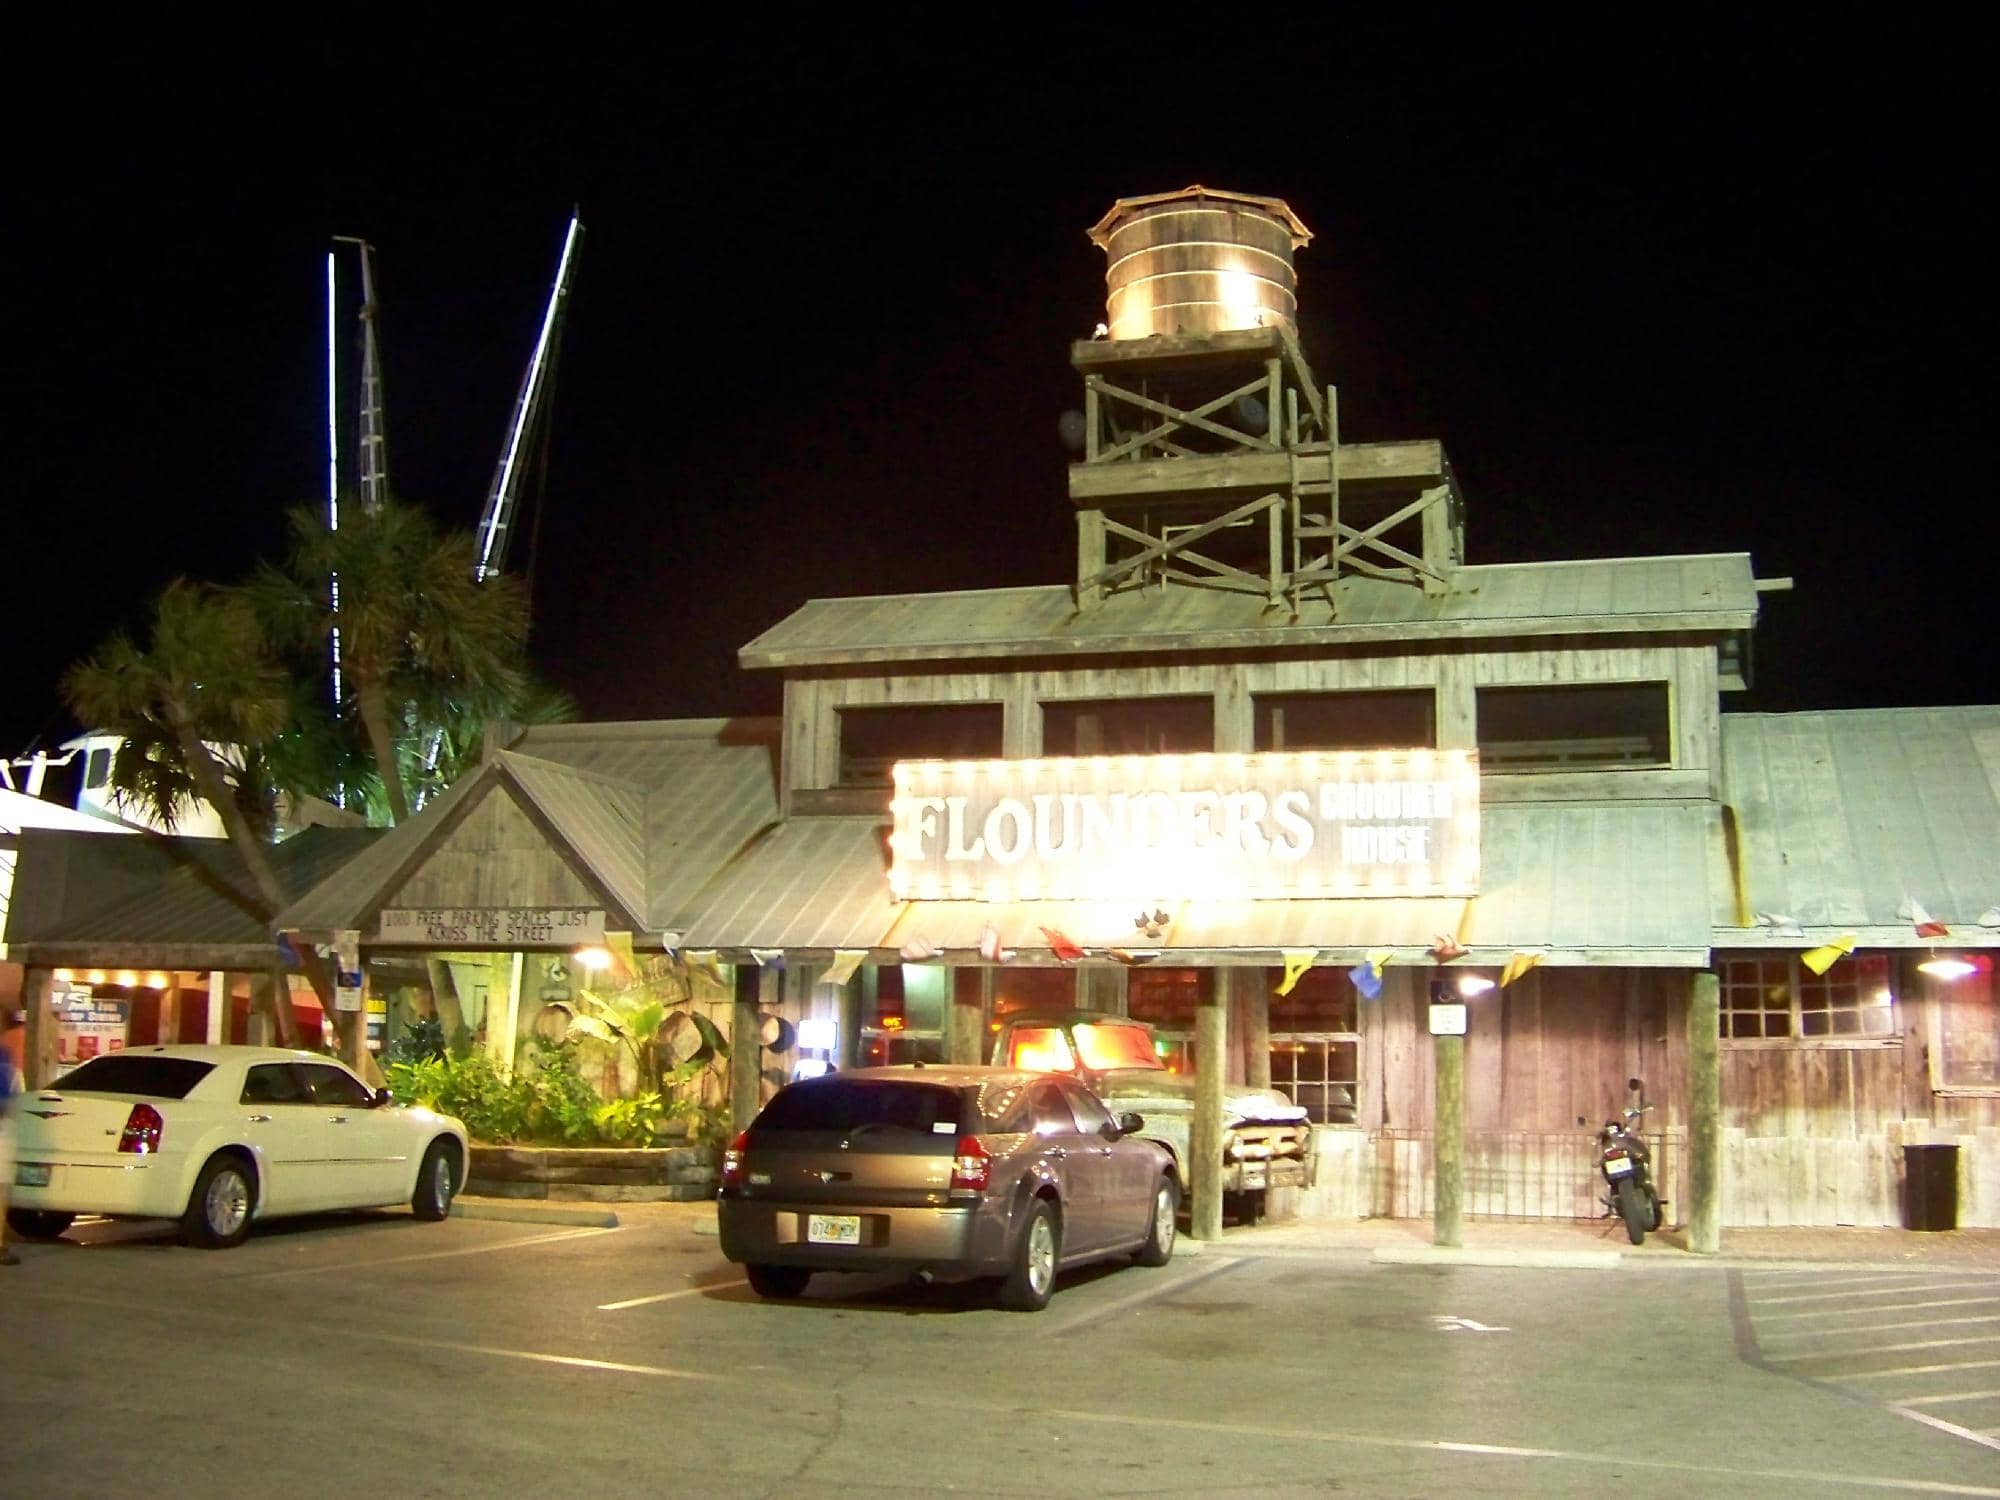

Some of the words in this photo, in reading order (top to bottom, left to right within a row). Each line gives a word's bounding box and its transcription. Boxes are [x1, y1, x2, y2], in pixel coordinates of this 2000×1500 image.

[902, 790, 1316, 865] FLOUNDERS
[1341, 826, 1431, 865] HOUSE
[416, 911, 444, 926] FREE
[452, 910, 499, 928] PARKING
[507, 910, 550, 926] SPACES
[558, 910, 589, 926] JUST
[426, 926, 468, 942] ACROSS
[475, 926, 498, 942] THE
[506, 926, 554, 942] STREET
